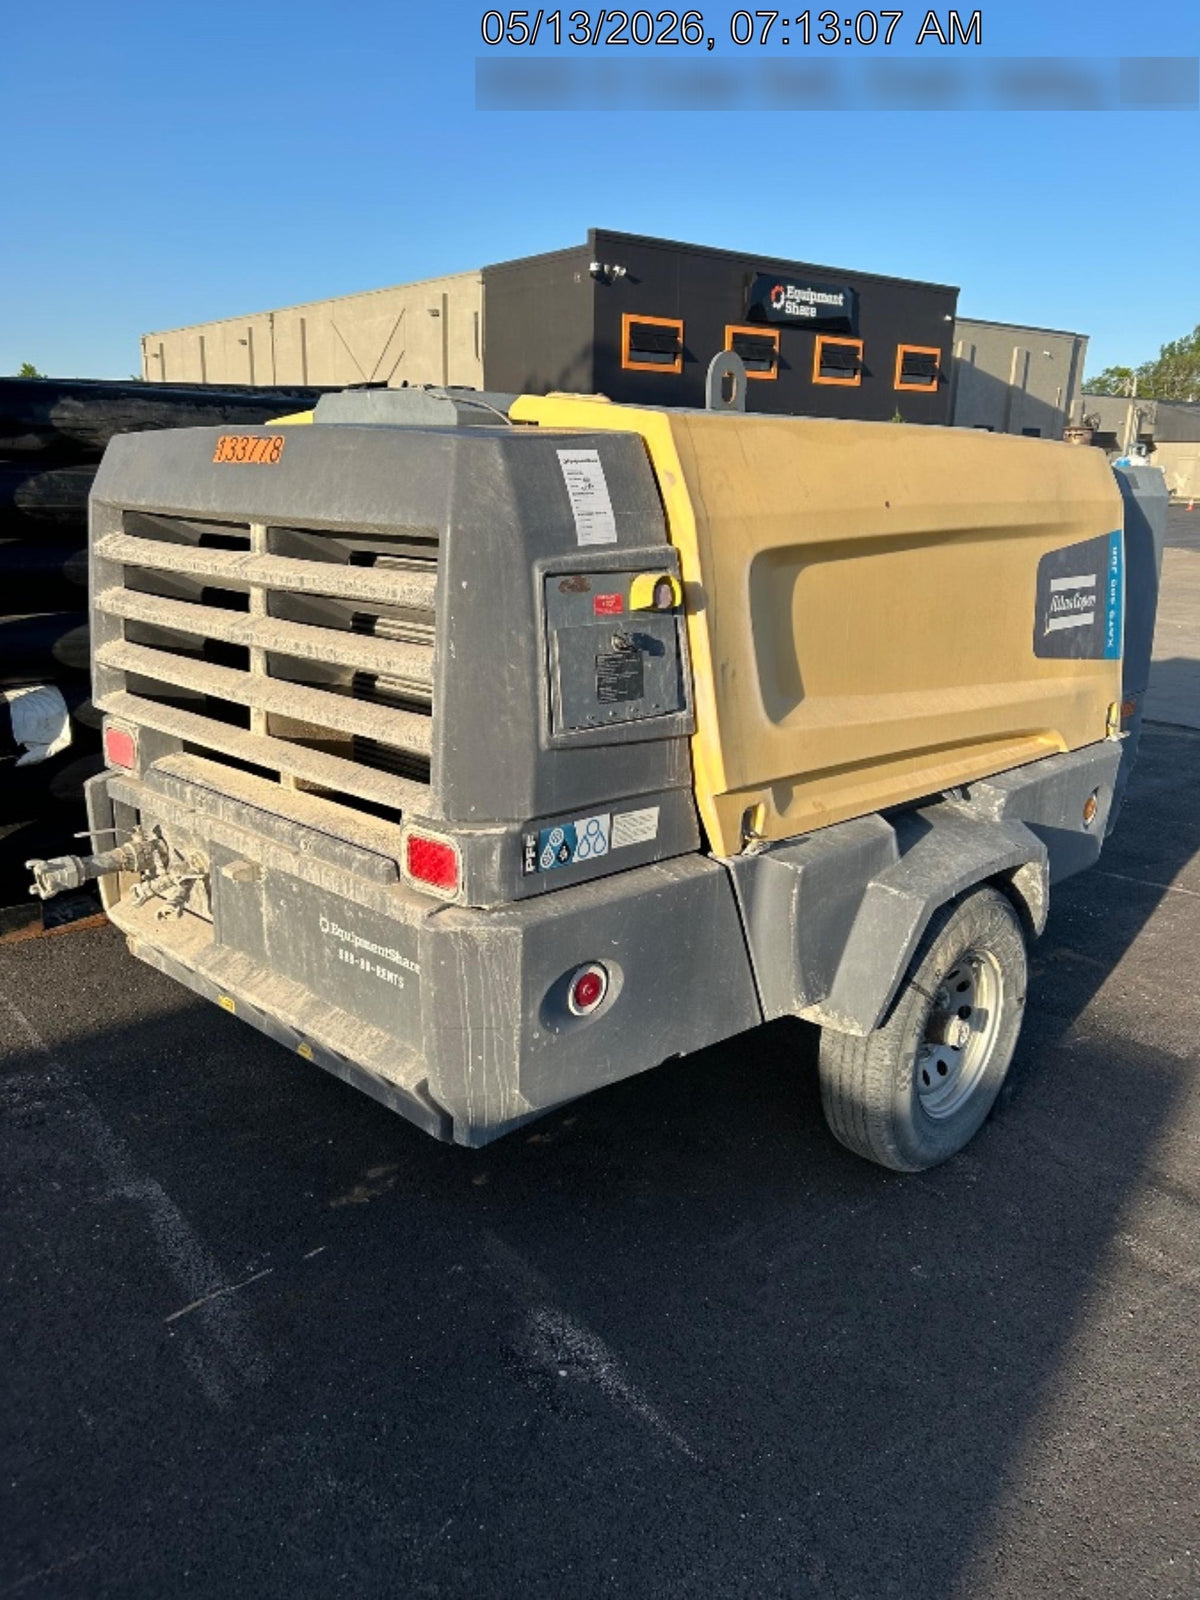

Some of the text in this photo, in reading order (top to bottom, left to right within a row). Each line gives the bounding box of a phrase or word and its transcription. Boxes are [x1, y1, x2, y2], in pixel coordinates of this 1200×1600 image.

[786, 285, 844, 307] Equipment
[785, 300, 817, 318] Share
[216, 436, 283, 462] 133778
